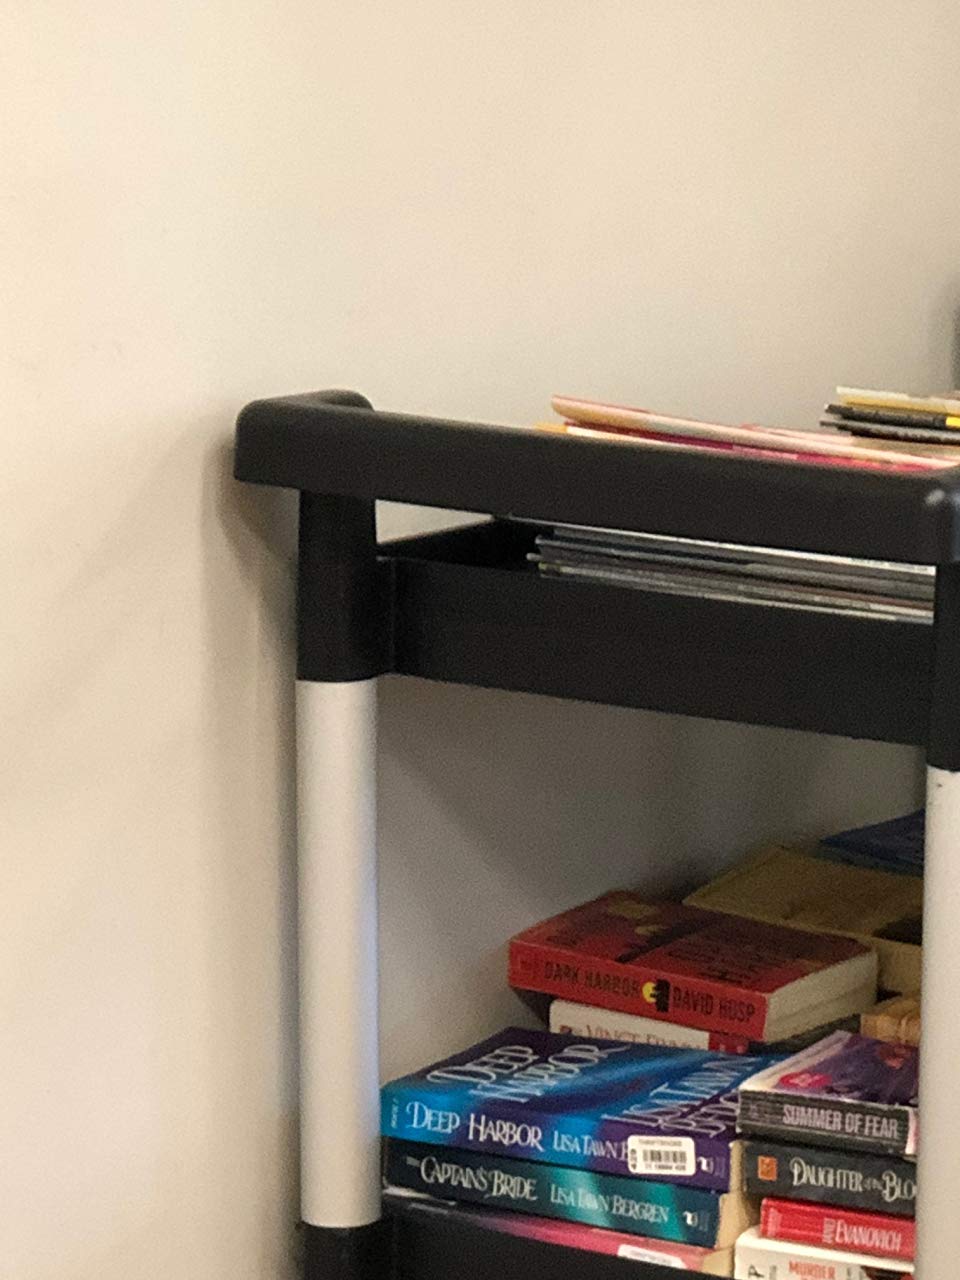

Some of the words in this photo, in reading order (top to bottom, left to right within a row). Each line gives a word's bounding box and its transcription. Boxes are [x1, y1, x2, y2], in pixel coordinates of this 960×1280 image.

[406, 1101, 460, 1134] DEEP
[468, 1112, 544, 1151] HARBOR
[553, 1130, 580, 1154] LISA
[783, 1104, 842, 1131] SUMMER
[844, 1111, 863, 1134] OF
[864, 1113, 899, 1138] FEAR
[485, 1169, 538, 1201] BRIDE
[550, 1183, 575, 1208] LISA
[612, 1194, 670, 1223] BERGREN
[789, 1157, 863, 1192] DAUGHTER
[881, 1170, 917, 1203] BLO
[835, 1219, 902, 1251] EVANOVICH
